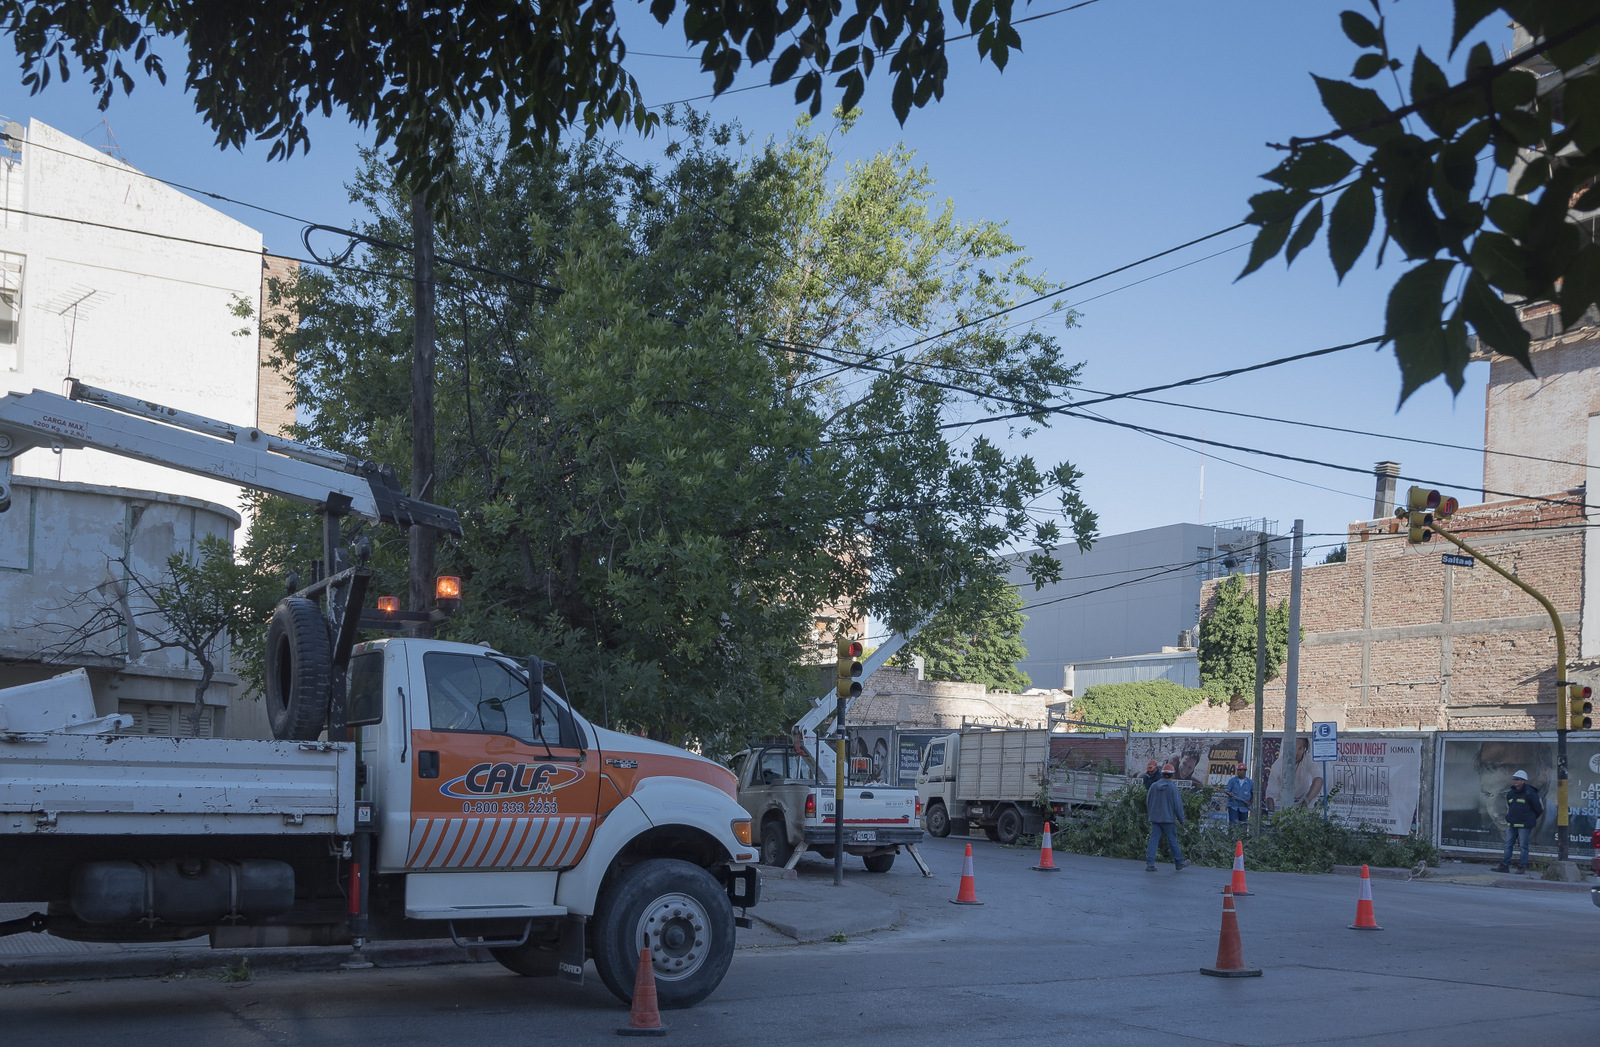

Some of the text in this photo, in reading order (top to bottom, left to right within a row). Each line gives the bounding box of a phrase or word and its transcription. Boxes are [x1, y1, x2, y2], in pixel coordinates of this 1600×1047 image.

[33, 420, 49, 428] 5200
[42, 416, 85, 431] CARGA MAX.
[1442, 555, 1464, 564] Salta
[1321, 726, 1328, 735] E
[1214, 750, 1238, 759] DICIEMBRE
[1337, 742, 1362, 755] FUSION
[1364, 743, 1387, 755] NIGHT
[1210, 762, 1236, 775] ROÑA
[464, 762, 558, 794] CALF
[1333, 765, 1389, 797] OZUNA
[1581, 791, 1594, 799] DE
[463, 801, 558, 814] 0-800 333 2253
[559, 962, 582, 975] FORD
